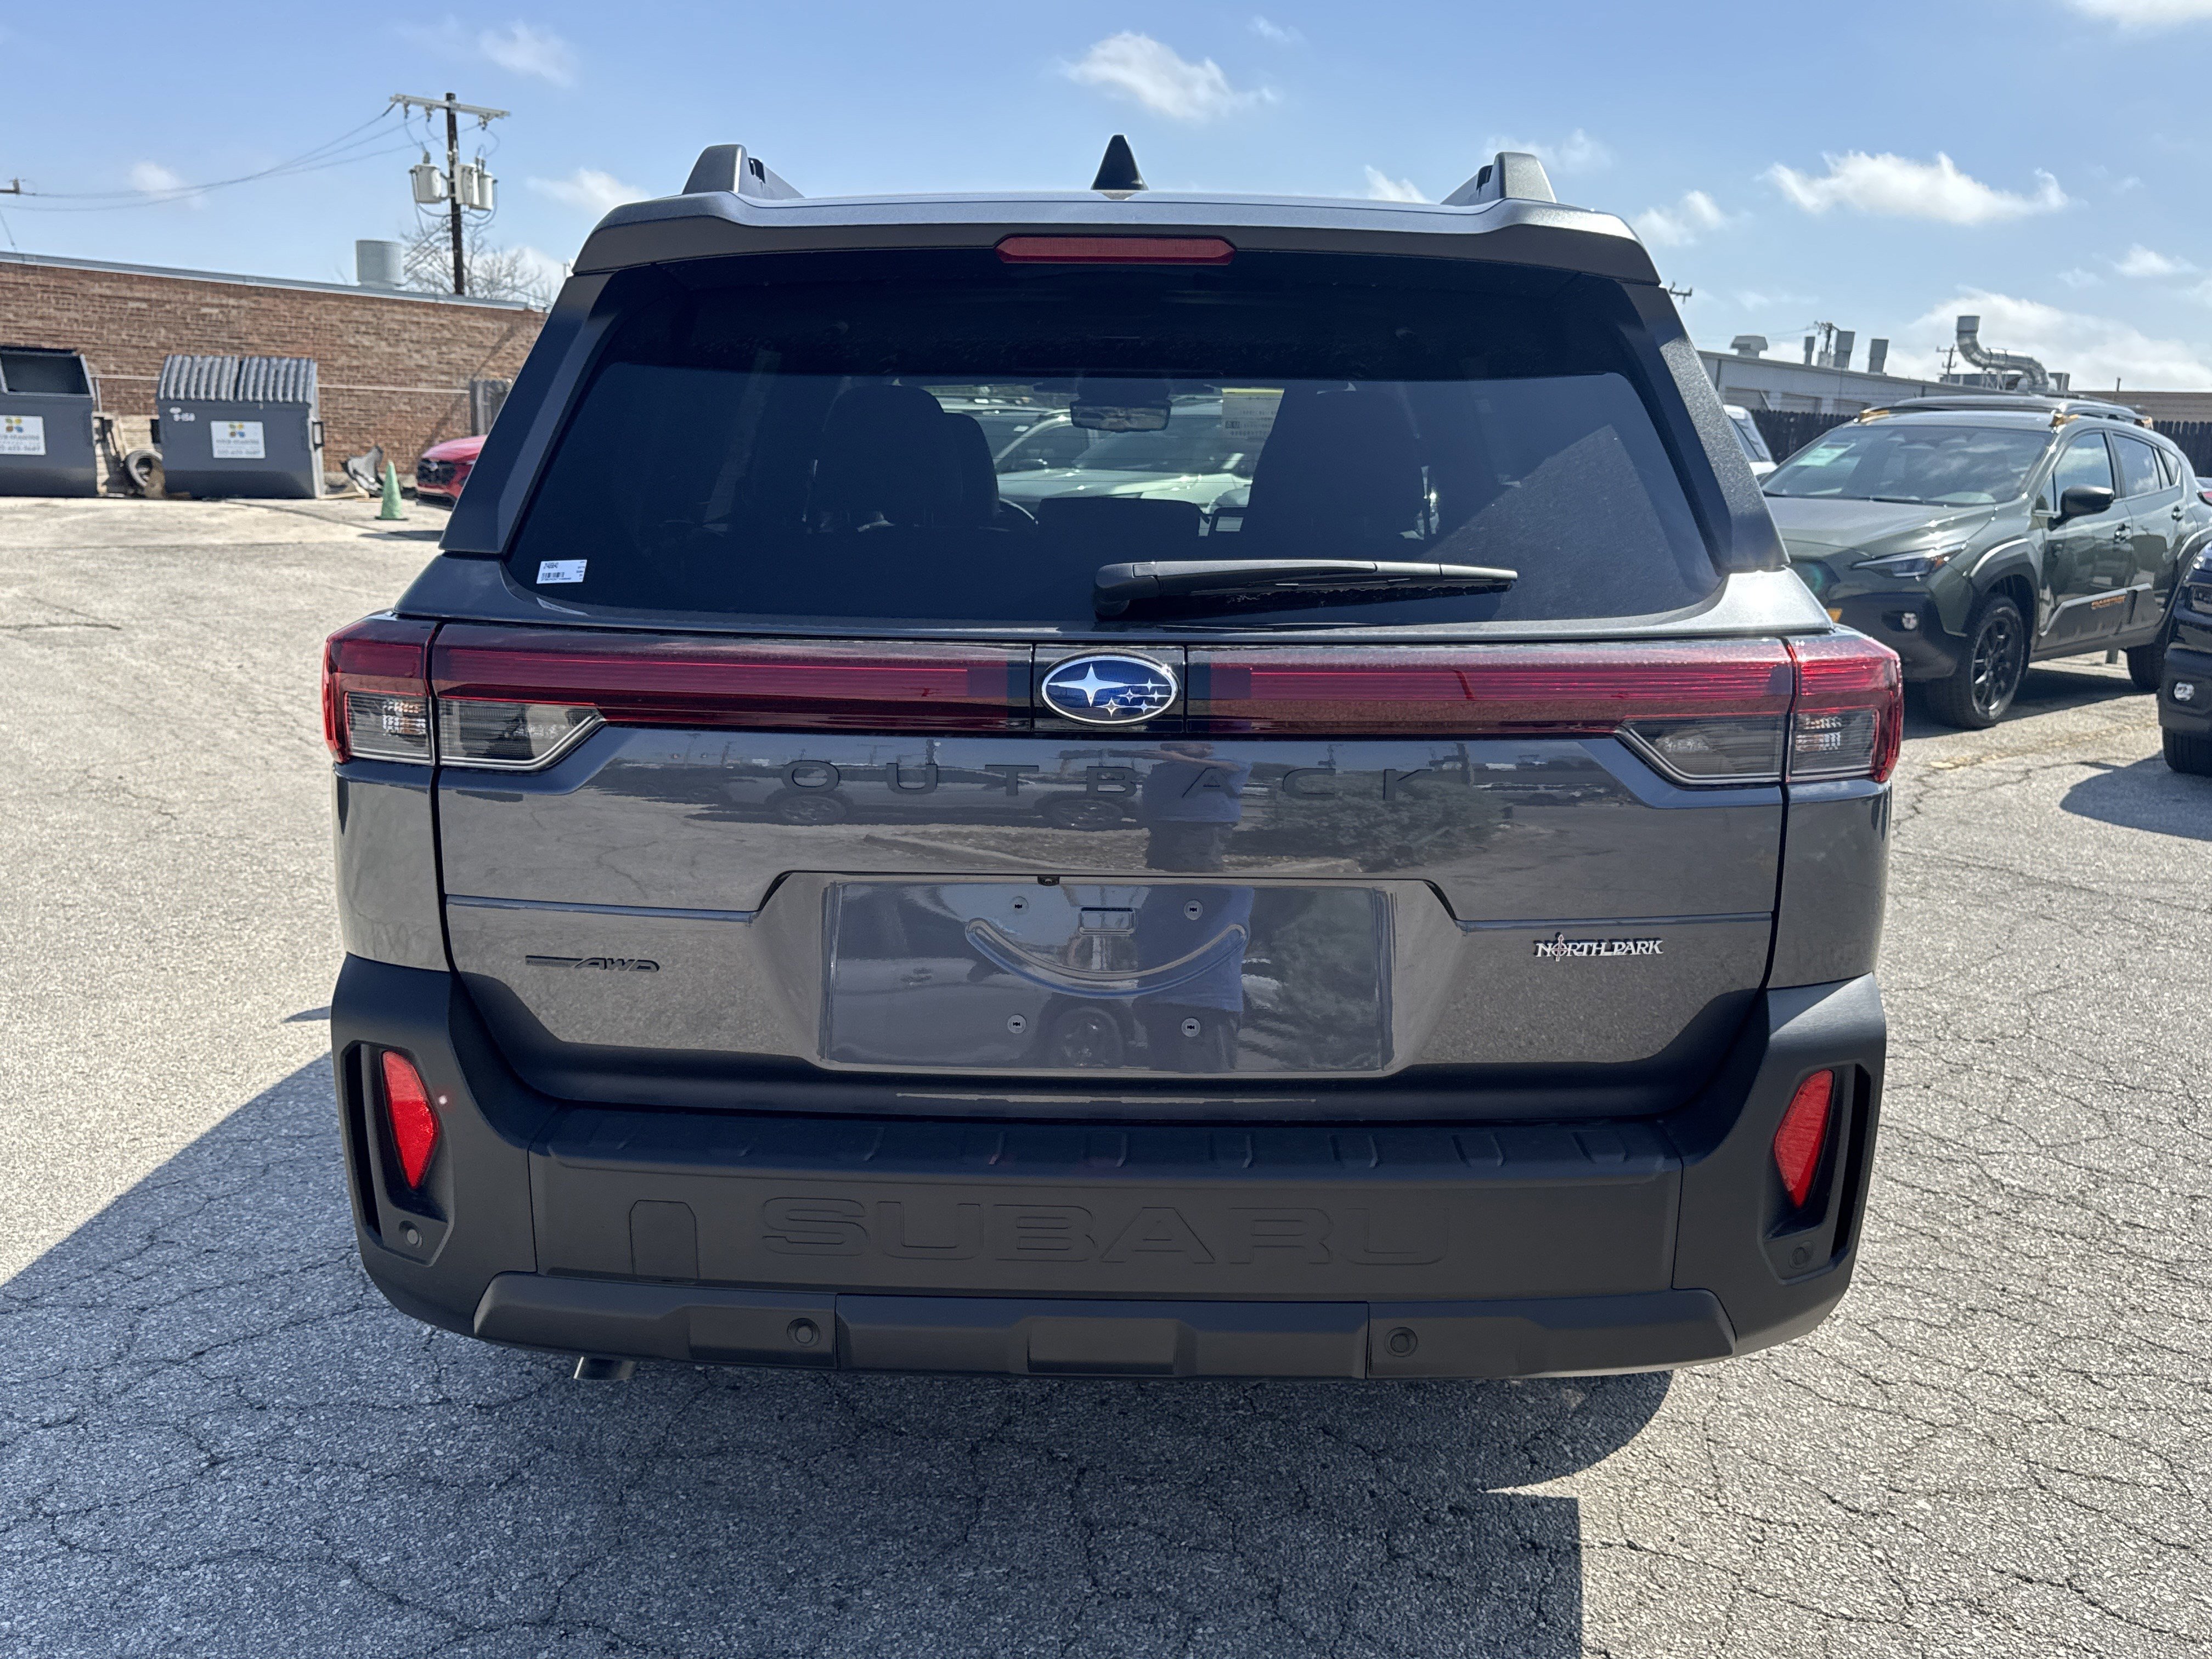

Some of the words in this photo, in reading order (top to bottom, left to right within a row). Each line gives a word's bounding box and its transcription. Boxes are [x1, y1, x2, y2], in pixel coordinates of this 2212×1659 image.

[780, 759, 1433, 801] OUTBACK
[1534, 934, 1607, 961] NORTH
[1611, 939, 1664, 957] PARK
[574, 957, 660, 973] AWD
[761, 1197, 1451, 1266] SUBARU
